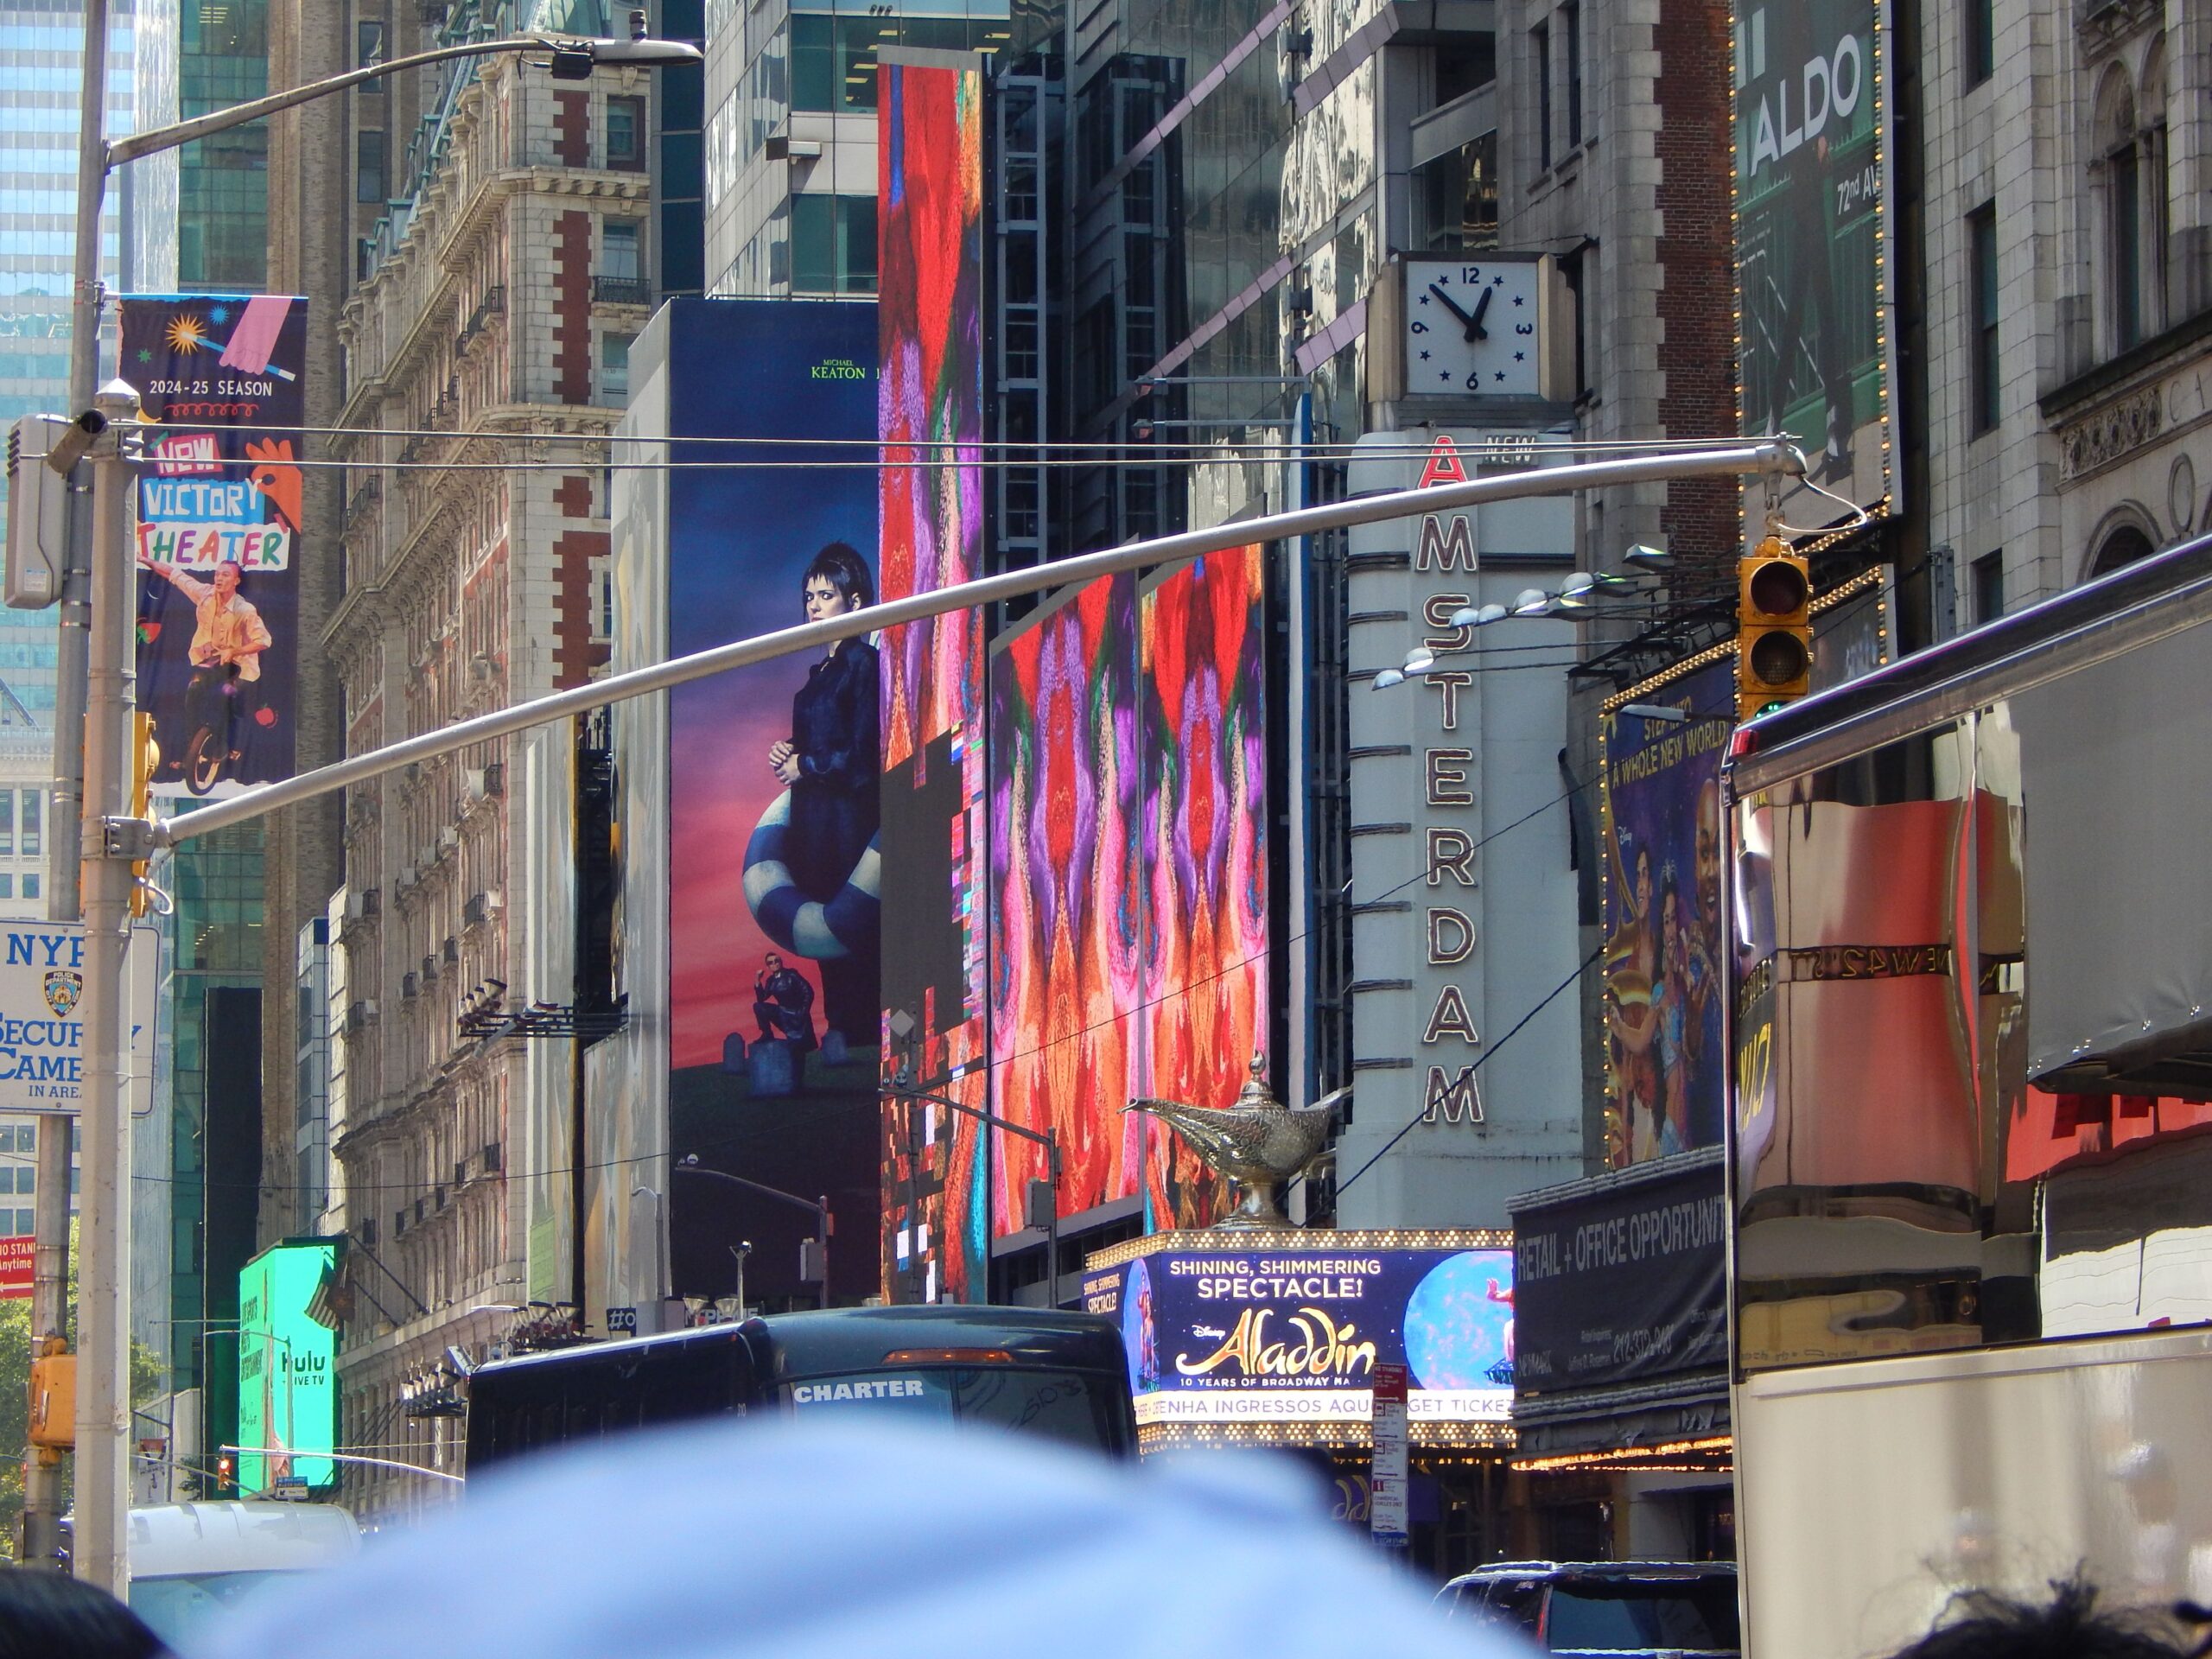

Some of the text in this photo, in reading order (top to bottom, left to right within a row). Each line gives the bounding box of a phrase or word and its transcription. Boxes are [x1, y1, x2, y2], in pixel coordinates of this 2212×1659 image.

[1751, 34, 1860, 177] ALDO
[1837, 175, 1859, 215] 72nd
[1462, 267, 1480, 284] 12
[1411, 321, 1429, 334] 9
[1516, 323, 1533, 335] 3
[811, 366, 865, 379] KEATON
[1466, 372, 1478, 391] 6
[149, 380, 272, 397] 2024-25 SEASON
[156, 437, 214, 474] NEW
[1486, 436, 1535, 462] NEW
[144, 477, 263, 517] VICTORY
[137, 523, 283, 566] THEATER
[1612, 760, 1619, 789] A
[1621, 745, 1658, 785] WHOLE
[1661, 734, 1684, 771] NEW
[1416, 435, 1484, 1123] AMSTERDAM
[6, 933, 85, 968] NYP
[29, 1084, 83, 1099] IN ARE
[1517, 1233, 1561, 1282] RETAIL
[1575, 1217, 1627, 1272] OFFICE
[1630, 1194, 1726, 1261] OPPORTUNIT
[1169, 1259, 1381, 1277] SHINING, SHIMMERING
[1198, 1277, 1363, 1298] SPECTACLE!
[1175, 1306, 1376, 1376] Aladdin
[282, 1351, 326, 1372] hulu
[294, 1376, 309, 1386] IVE
[312, 1376, 325, 1385] TV
[793, 1380, 924, 1403] CHARTER
[1180, 1377, 1192, 1387] 10
[1198, 1377, 1236, 1387] YEARS
[1241, 1377, 1257, 1387] OF
[1262, 1376, 1329, 1387] BROADWAY
[1215, 1399, 1322, 1414] INGRESSOS
[1329, 1399, 1372, 1414] AQU
[1408, 1398, 1441, 1413] GET
[1457, 1398, 1514, 1414] TICKET
